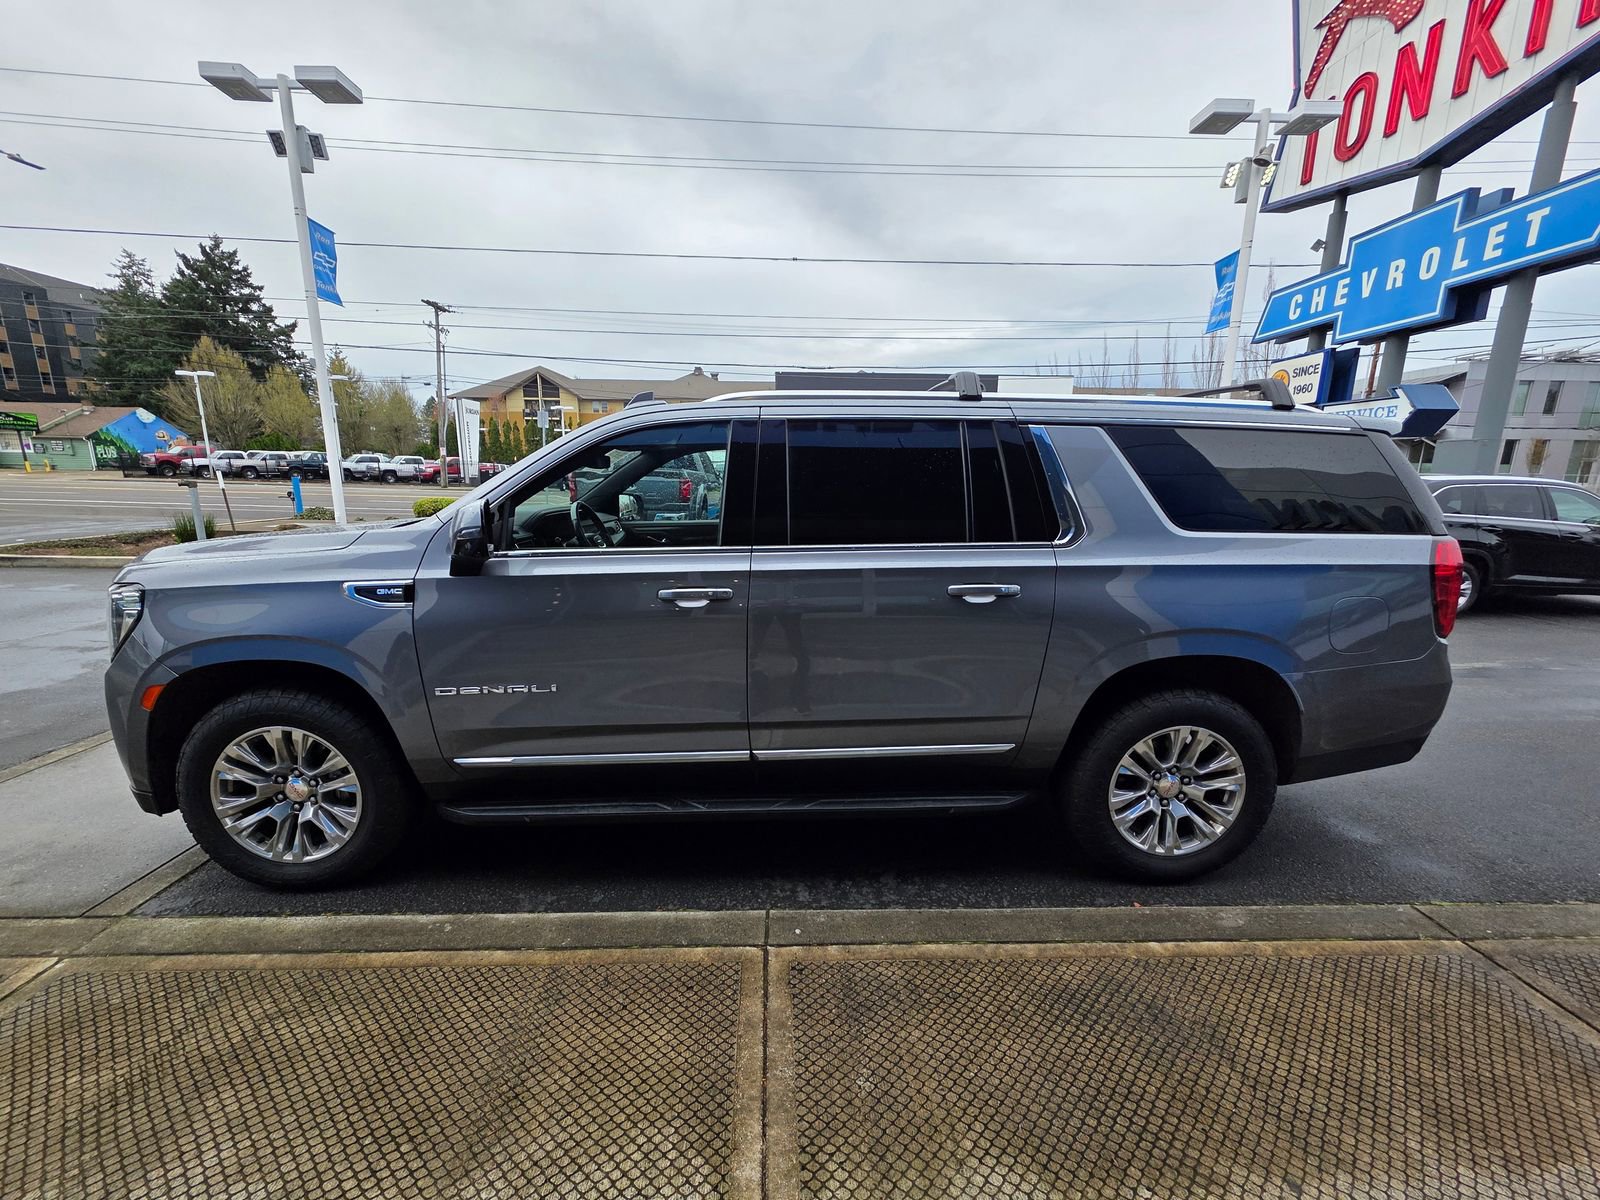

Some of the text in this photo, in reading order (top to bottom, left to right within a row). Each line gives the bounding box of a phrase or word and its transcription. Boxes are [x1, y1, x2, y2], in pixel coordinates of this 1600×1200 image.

[1300, 0, 1600, 186] ONKI
[1289, 206, 1551, 321] CHEVROLET
[1292, 363, 1320, 379] SINCE
[1293, 382, 1313, 395] 1960
[1328, 405, 1398, 418] RVICE
[96, 445, 118, 458] PLUS
[434, 684, 557, 696] DENALI
